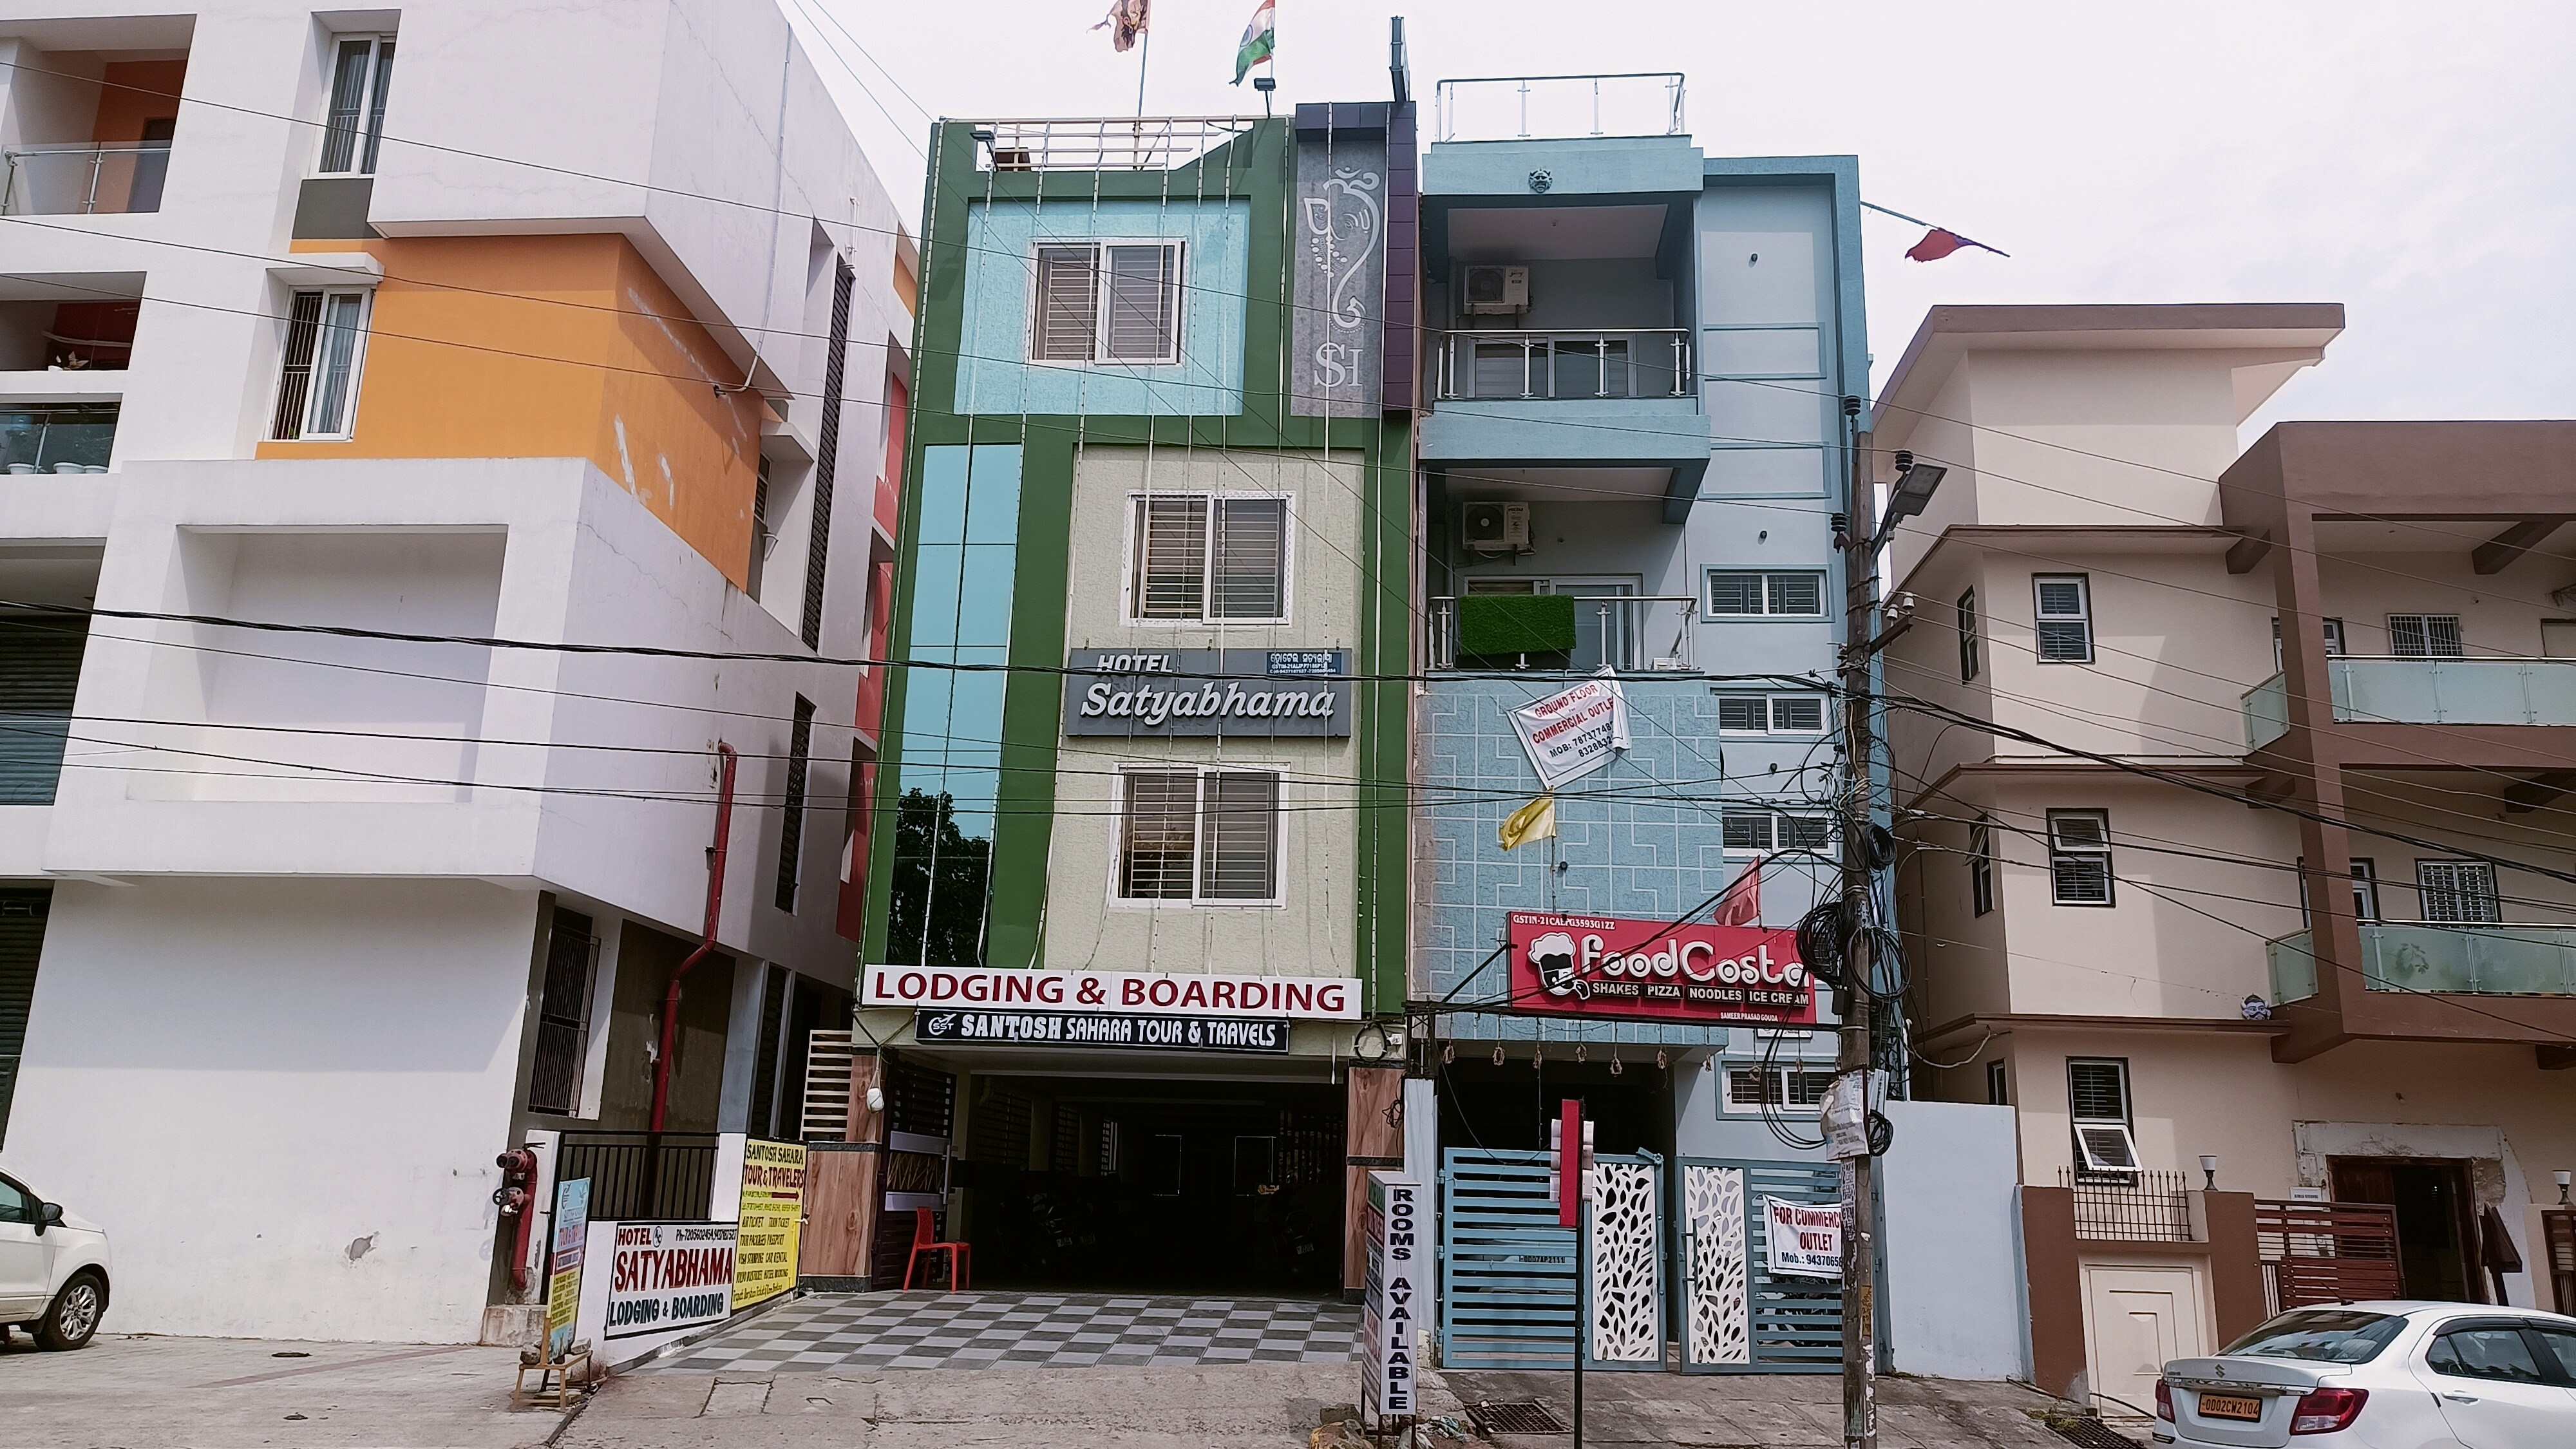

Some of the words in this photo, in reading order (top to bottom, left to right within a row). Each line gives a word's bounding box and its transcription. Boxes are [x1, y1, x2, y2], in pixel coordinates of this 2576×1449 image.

[1097, 654, 1173, 674] HOTEL
[1080, 681, 1335, 725] Satyabhama
[1535, 696, 1569, 718] GROUND
[1569, 685, 1598, 703] FLOOR
[1532, 712, 1588, 744] COMMERCIAL
[1587, 695, 1614, 717] OUTLE
[1549, 743, 1572, 758] MOB:
[1572, 721, 1614, 746] 78737748
[1578, 735, 1613, 757] 8328832
[875, 971, 1064, 1005] LODGING
[1075, 976, 1108, 1006] &
[1121, 978, 1346, 1013] BOARDING
[1593, 983, 1639, 996] SHAKES
[1647, 985, 1681, 997] PIZZA
[1689, 987, 1743, 1001] NOODLES
[1749, 990, 1768, 1003] ICE
[1770, 992, 1809, 1005] CREAM
[961, 1014, 1062, 1040] SANTOSH
[1066, 1018, 1135, 1043] SAHARA
[1137, 1019, 1183, 1043] TOUR
[1188, 1021, 1202, 1045] &
[1207, 1021, 1276, 1047] TRAVELS
[1741, 1012, 1761, 1021] PRASAD
[1761, 1014, 1779, 1022] GOUDA
[746, 1144, 777, 1162] SANTOSH
[777, 1147, 804, 1166] SAHARA
[744, 1164, 763, 1188] TOUR
[763, 1170, 768, 1188] &
[768, 1166, 805, 1190] TRAVELERS
[1389, 1189, 1414, 1261] ROOMS
[1773, 1206, 1793, 1224] FOR
[1795, 1208, 1842, 1229] COMMERCI
[618, 1227, 652, 1246] HOTEL
[1800, 1231, 1833, 1251] OUTLET
[614, 1247, 733, 1293] SATYABHAMA
[609, 1298, 660, 1327] LODGING
[662, 1301, 669, 1318] &
[671, 1292, 724, 1320] BOARDING
[1387, 1277, 1412, 1410] AVAILABLE
